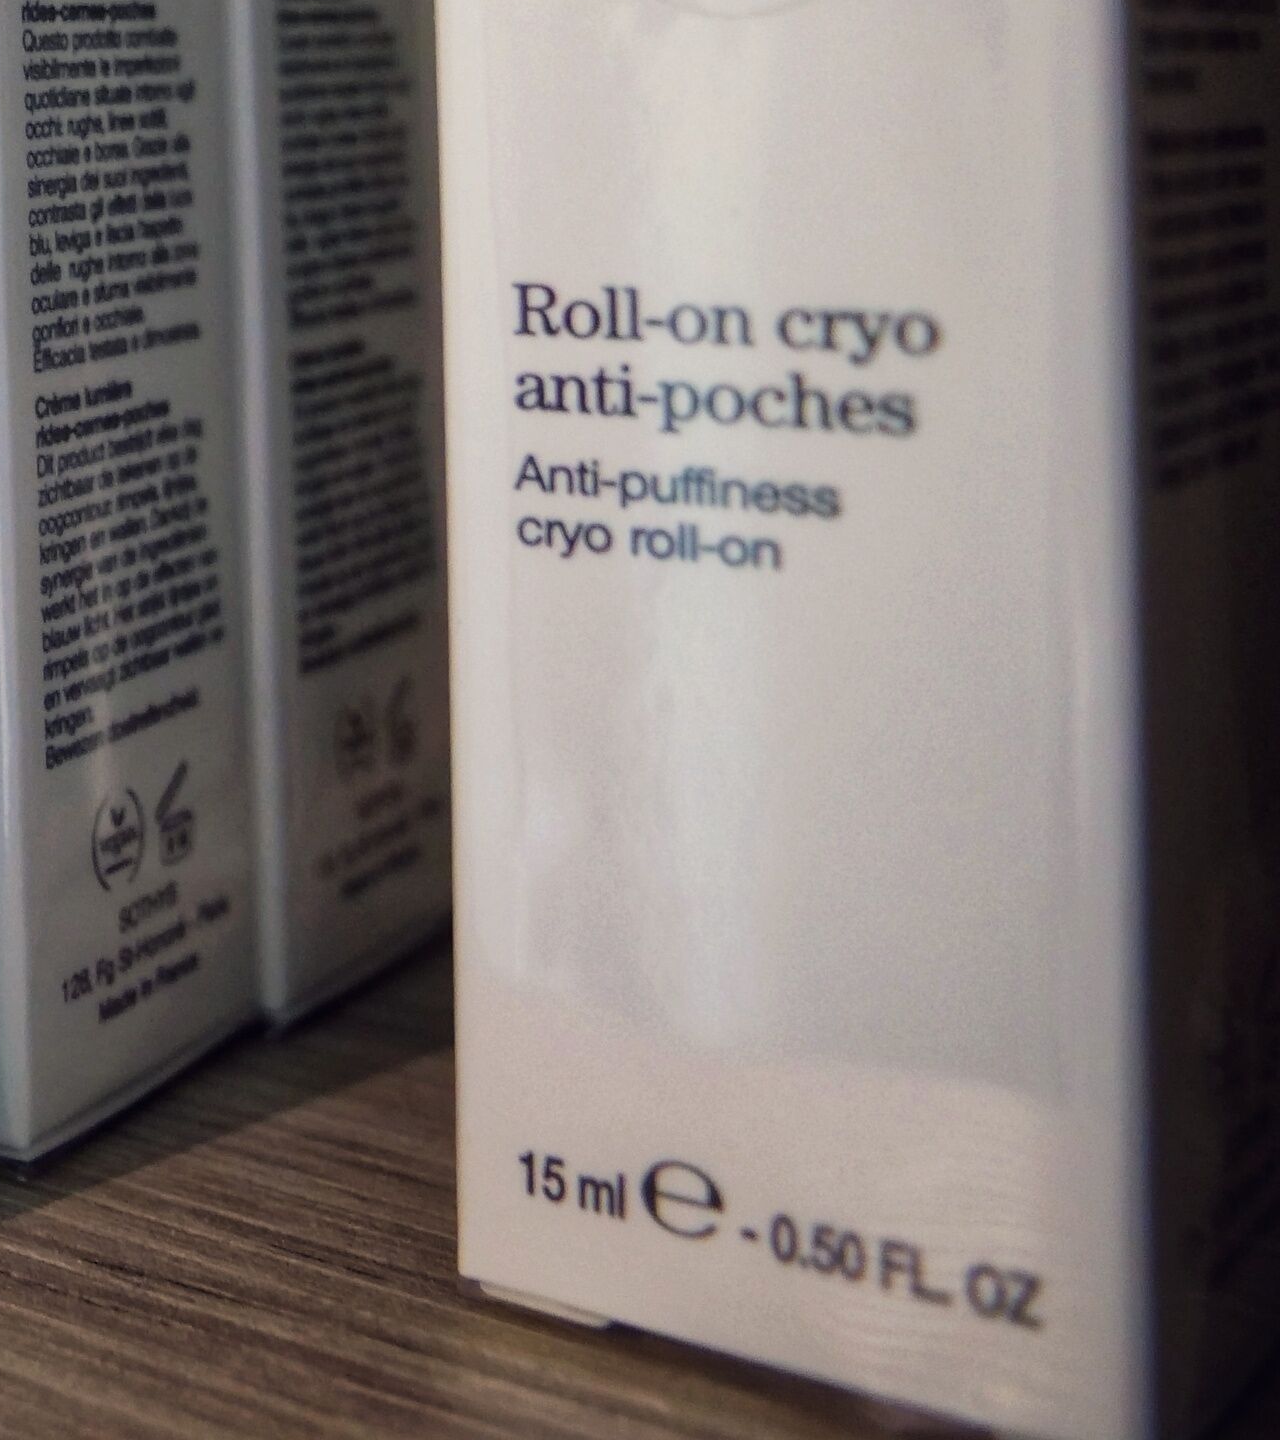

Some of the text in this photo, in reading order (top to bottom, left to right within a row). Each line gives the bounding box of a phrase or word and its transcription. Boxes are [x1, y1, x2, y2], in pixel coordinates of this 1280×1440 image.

[512, 282, 942, 365] Roll-on cryo
[514, 363, 918, 438] anti-poches
[513, 453, 842, 520] Anti-puffiness
[517, 515, 782, 571] cryo roll-on
[520, 1150, 565, 1203] 15
[578, 1173, 626, 1219] ml
[770, 1213, 866, 1281] 0.50
[966, 1263, 1044, 1331] OZ
